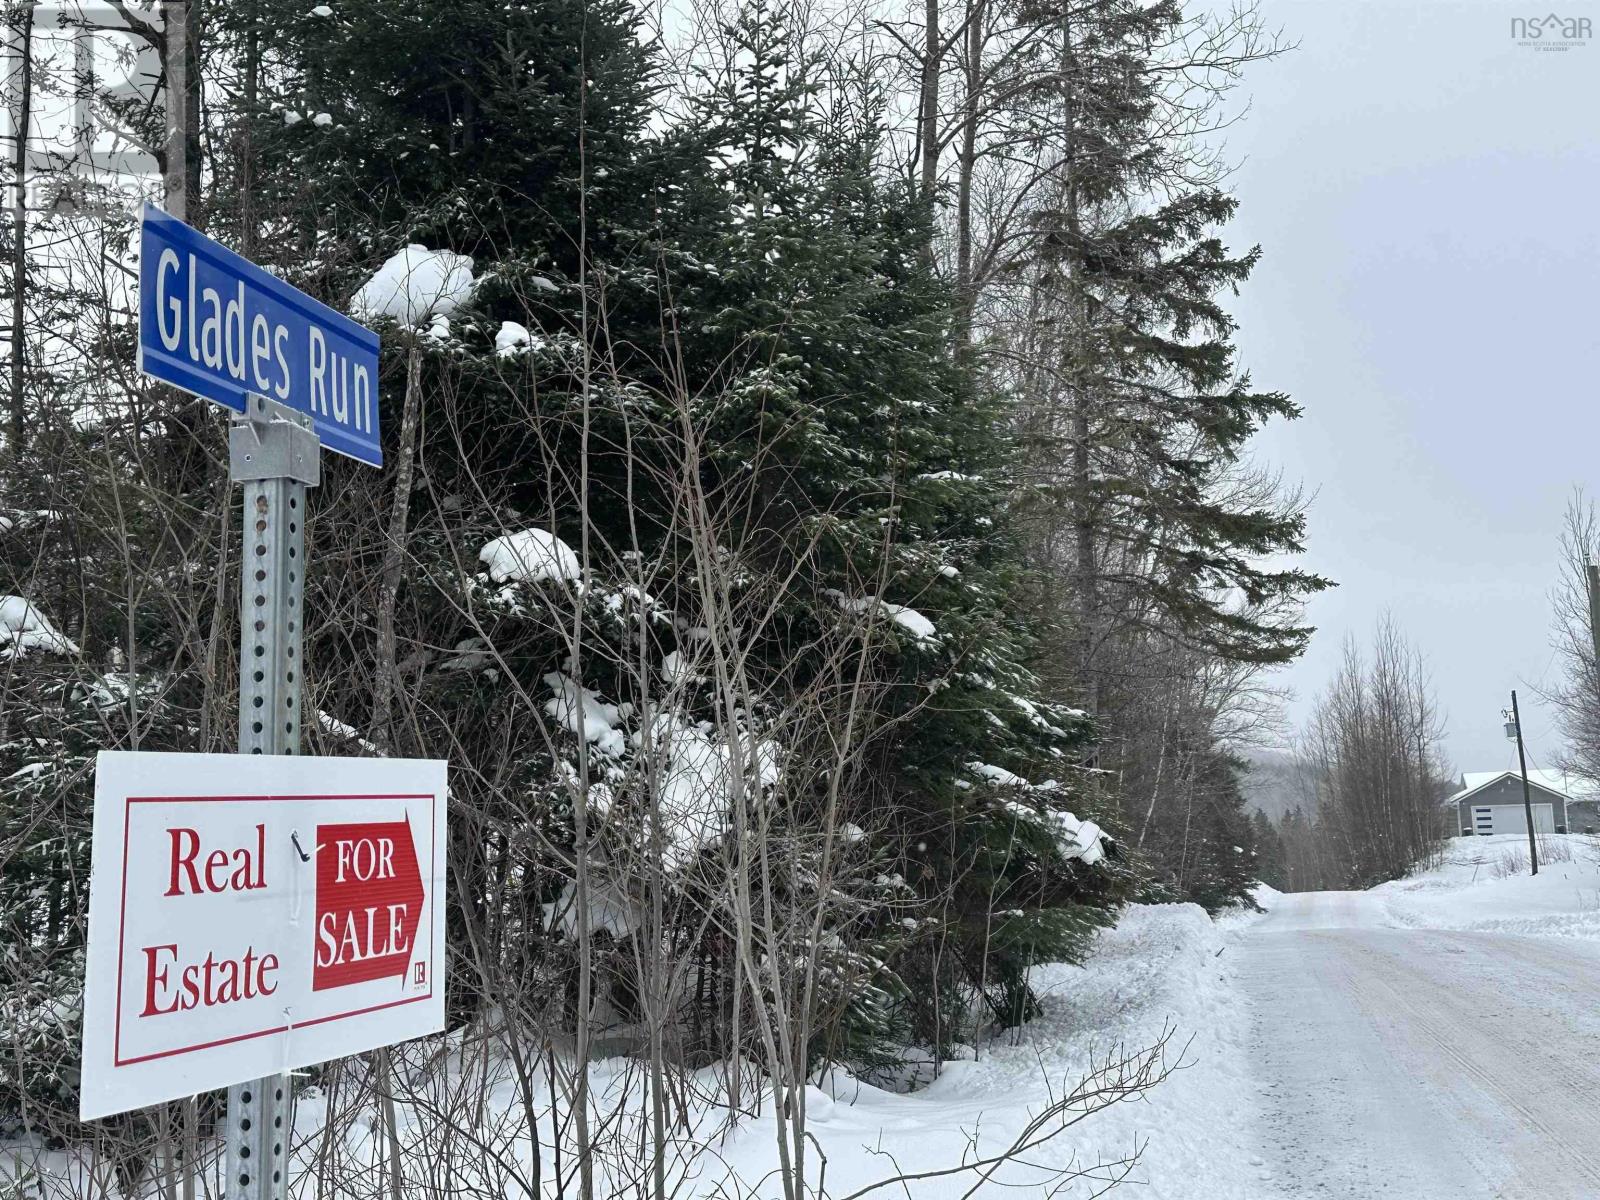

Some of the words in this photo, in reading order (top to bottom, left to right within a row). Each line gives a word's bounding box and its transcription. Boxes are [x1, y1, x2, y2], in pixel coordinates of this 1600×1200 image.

[156, 248, 290, 399] Glades
[309, 325, 371, 434] Run
[163, 823, 267, 896] Real
[335, 837, 396, 883] FOR
[316, 903, 409, 968] SALE
[138, 944, 279, 1018] Estate
